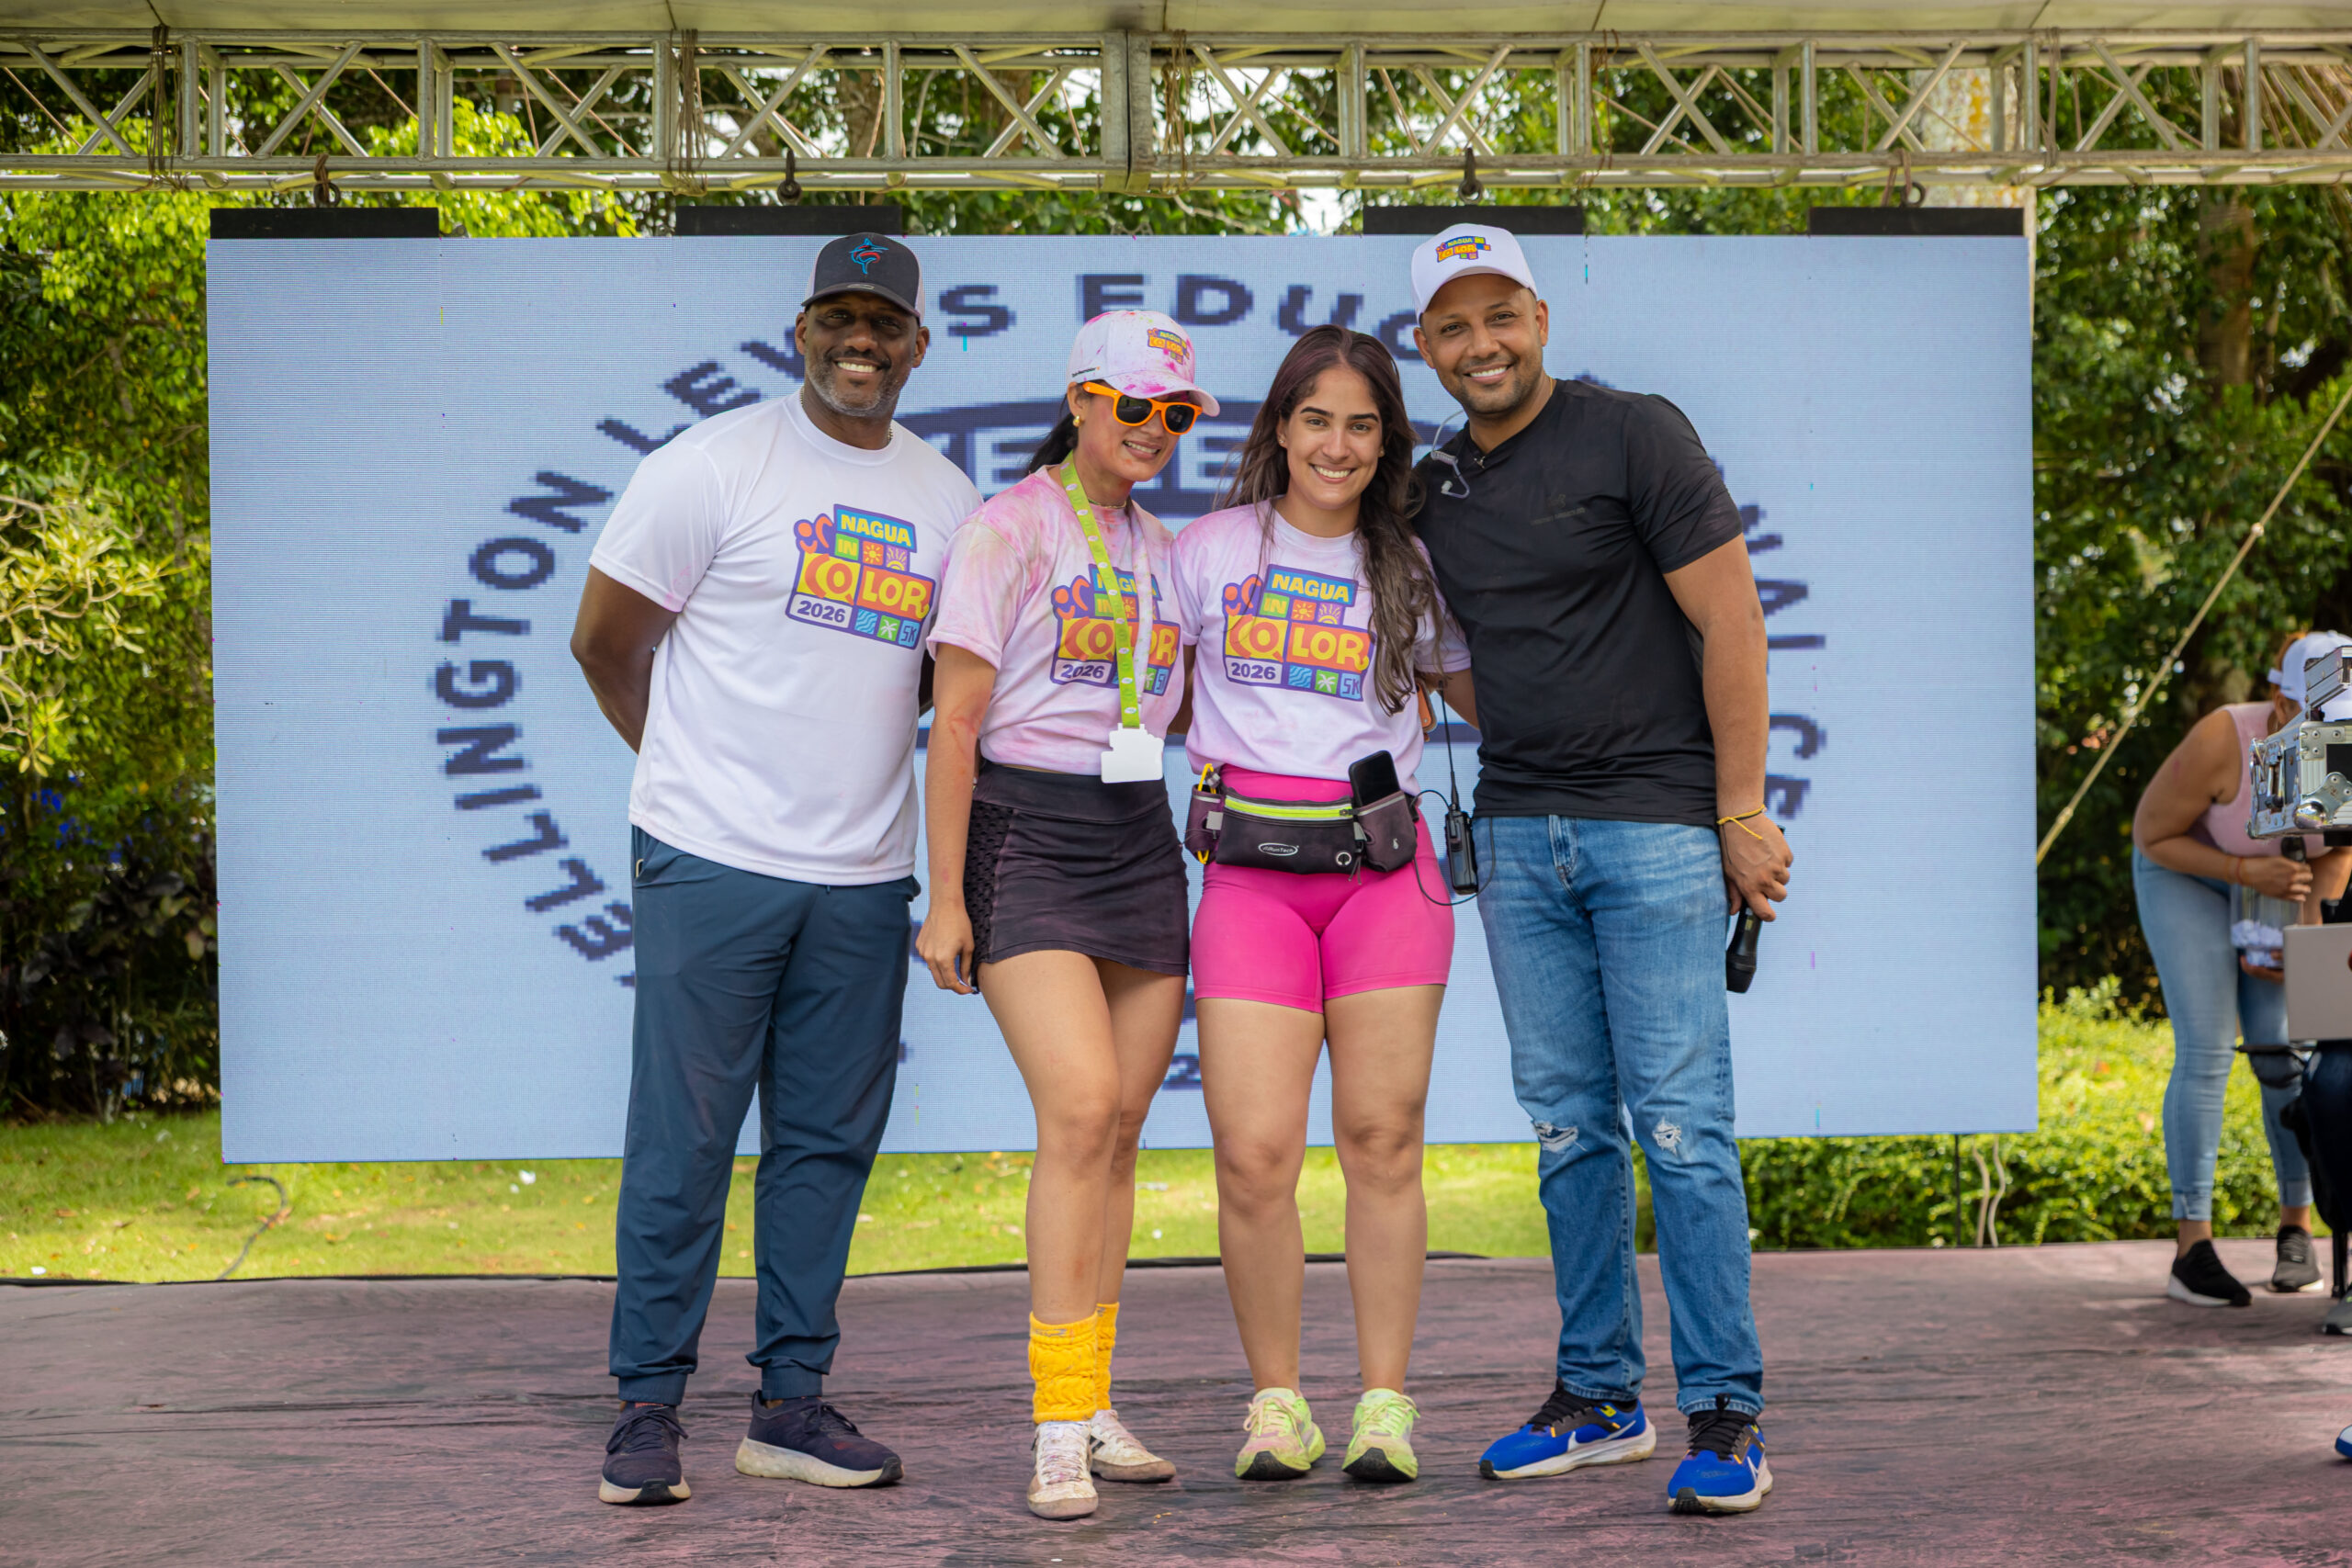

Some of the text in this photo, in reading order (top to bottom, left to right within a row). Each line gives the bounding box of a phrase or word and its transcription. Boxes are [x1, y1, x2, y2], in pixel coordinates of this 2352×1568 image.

[841, 514, 911, 547] NAGUA
[837, 538, 857, 557] IN
[805, 553, 930, 619] COLOR
[1272, 574, 1350, 603] NAGUA
[797, 600, 846, 623] 2026
[1263, 598, 1287, 614] IN
[900, 626, 918, 643] 5K
[1229, 614, 1370, 671] COLOR
[1061, 664, 1105, 679] 2026
[1231, 662, 1276, 680] 2026
[1342, 678, 1360, 696] 5K
[432, 469, 635, 987] ELLINGTON
